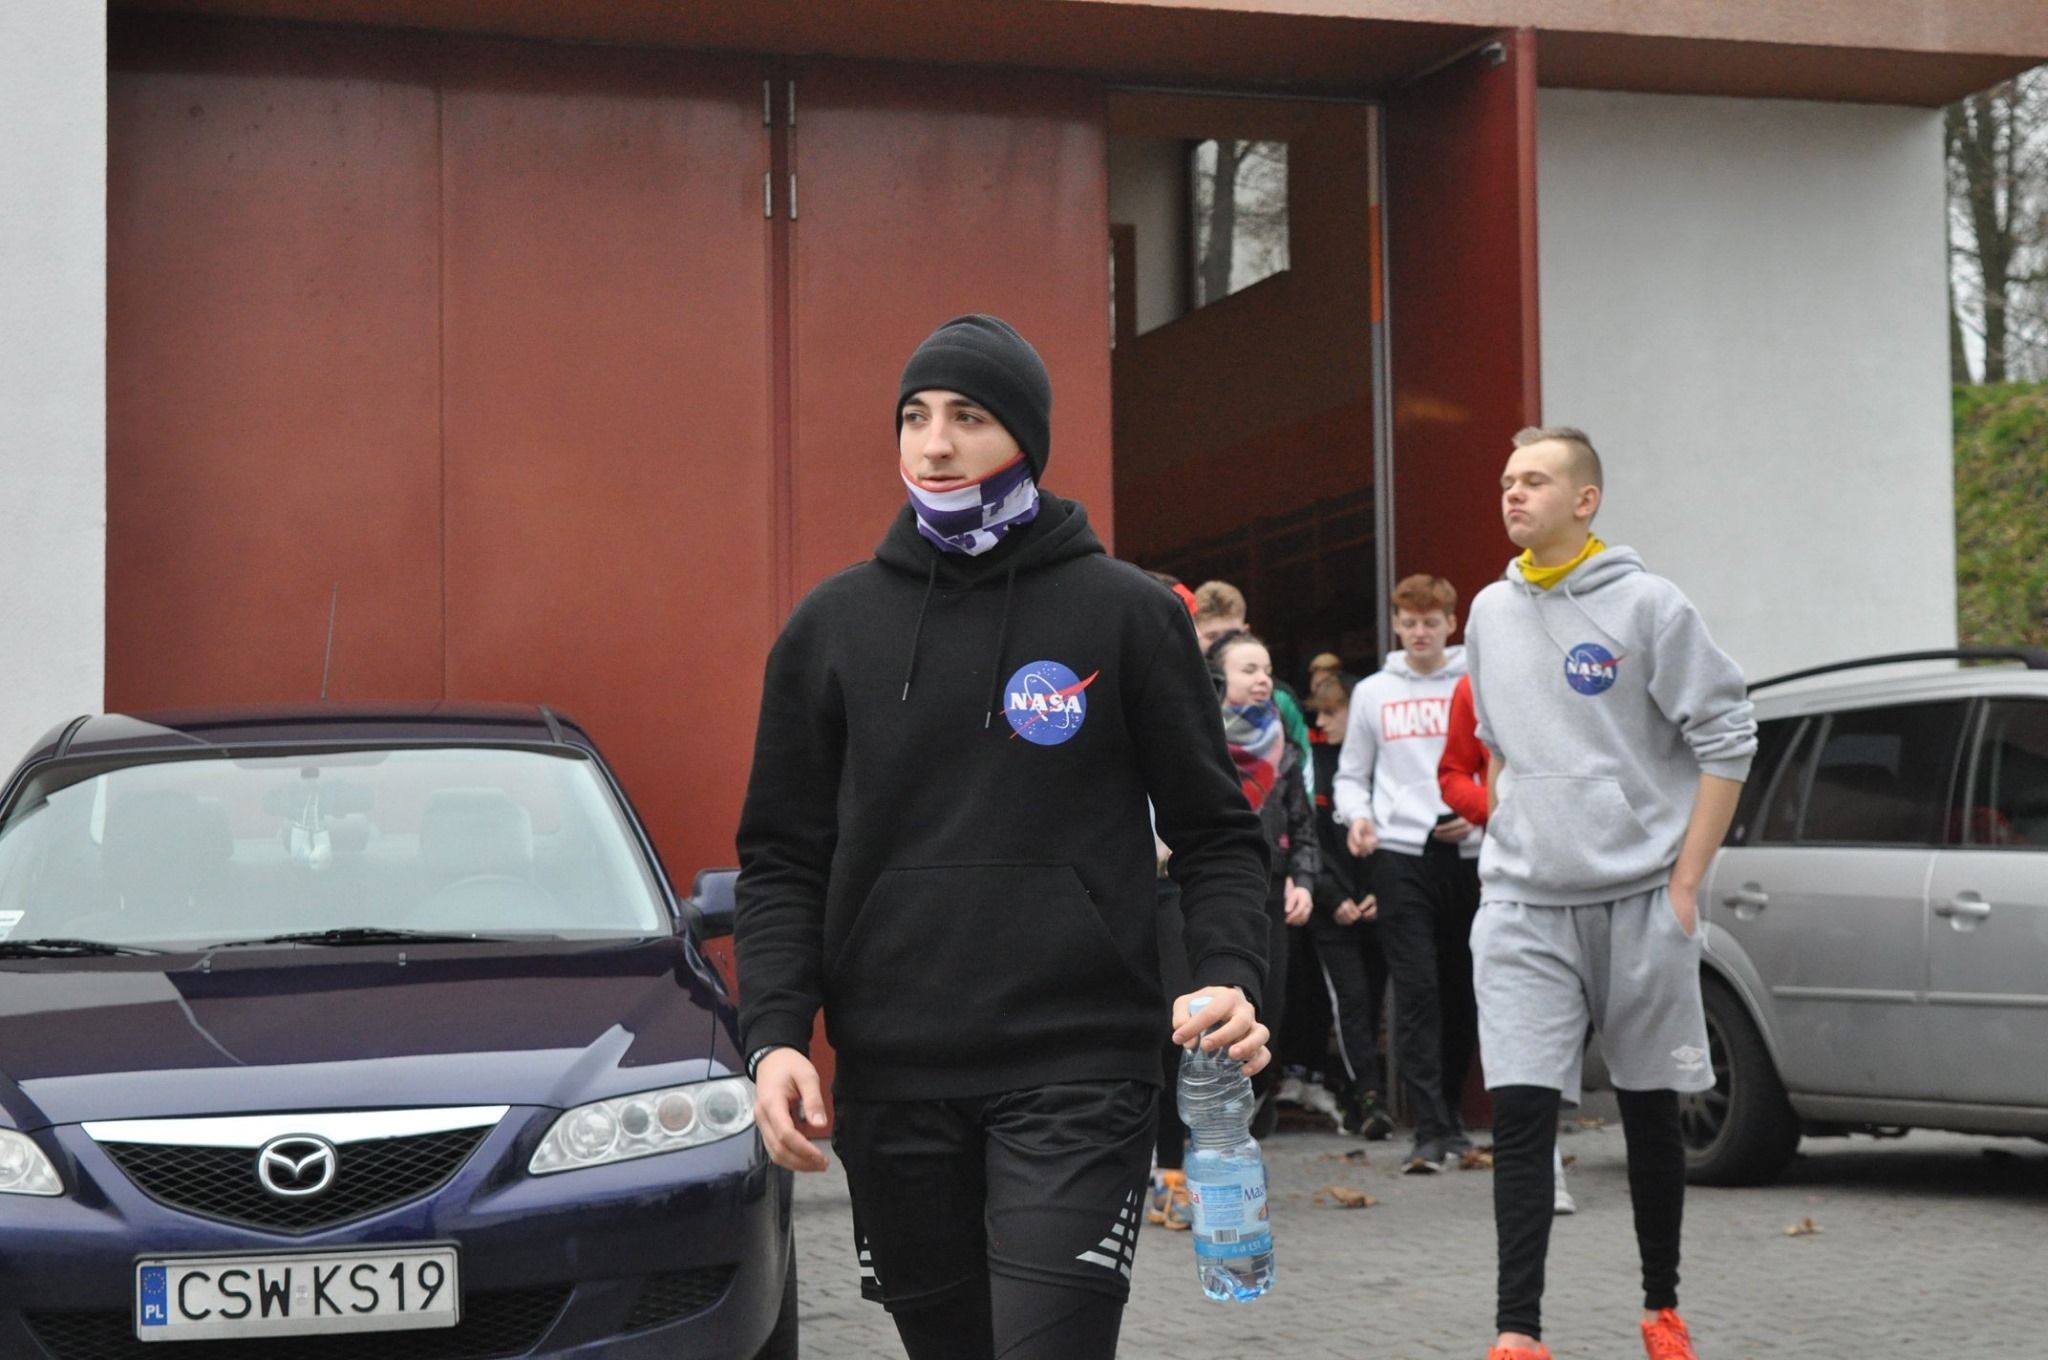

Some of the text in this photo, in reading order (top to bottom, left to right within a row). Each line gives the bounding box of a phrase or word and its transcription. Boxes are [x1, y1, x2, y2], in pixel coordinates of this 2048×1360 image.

[1567, 661, 1614, 680] NASA
[1010, 692, 1083, 714] NASA
[177, 1260, 445, 1321] CSW KS19
[145, 1304, 165, 1320] PL
